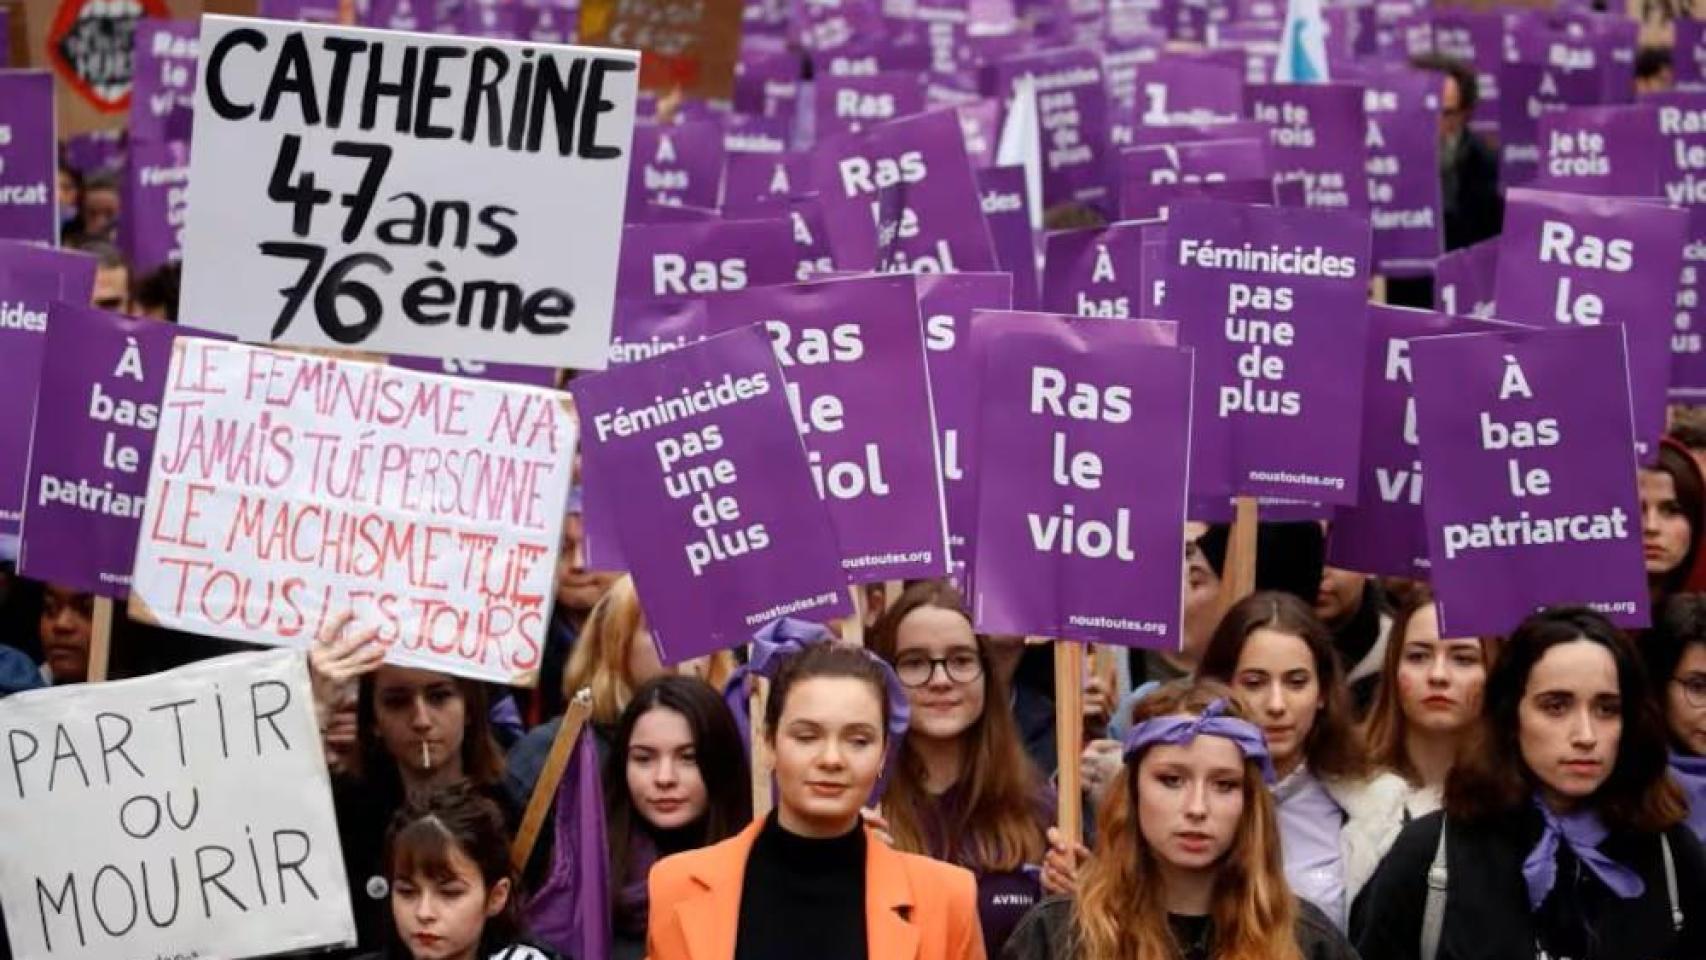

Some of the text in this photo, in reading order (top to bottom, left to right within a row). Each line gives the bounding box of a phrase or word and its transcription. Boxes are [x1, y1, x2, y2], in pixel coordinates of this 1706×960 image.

[838, 150, 928, 197] Ras
[1550, 151, 1611, 177] crois
[267, 134, 393, 244] 47
[375, 191, 519, 257] ans
[1179, 238, 1357, 279] Féminicides
[1538, 219, 1635, 274] Ras
[257, 241, 576, 345] 76 ème
[652, 253, 748, 295] Ras
[1228, 282, 1295, 317] pas
[1554, 276, 1605, 326] le
[1224, 317, 1295, 347] une
[113, 338, 145, 383] À
[1237, 347, 1285, 381] de
[1499, 354, 1534, 401] À
[89, 382, 159, 431] bas
[173, 344, 231, 395] LE
[487, 392, 559, 453] N'A
[593, 371, 771, 443] Féminicides
[1029, 365, 1133, 425] Ras
[1219, 380, 1301, 418] plus
[103, 431, 140, 473] le
[655, 422, 724, 473] pas
[1480, 410, 1561, 450] bas
[663, 457, 738, 499] une
[1052, 430, 1104, 490] le
[1248, 468, 1346, 490] noustoutes.org
[1508, 458, 1552, 499] le
[376, 443, 556, 530] PERSONNE
[691, 492, 741, 528] de
[151, 480, 549, 606] LE MACHISME TUE
[685, 522, 771, 577] plus
[1027, 504, 1135, 562] viol
[1443, 505, 1629, 560] patriarcat
[158, 556, 308, 638] TOUS
[401, 597, 542, 670] JOURS
[745, 590, 838, 626] noustoutes.org
[1069, 613, 1168, 636] noustoutes.org
[119, 787, 201, 840] OU
